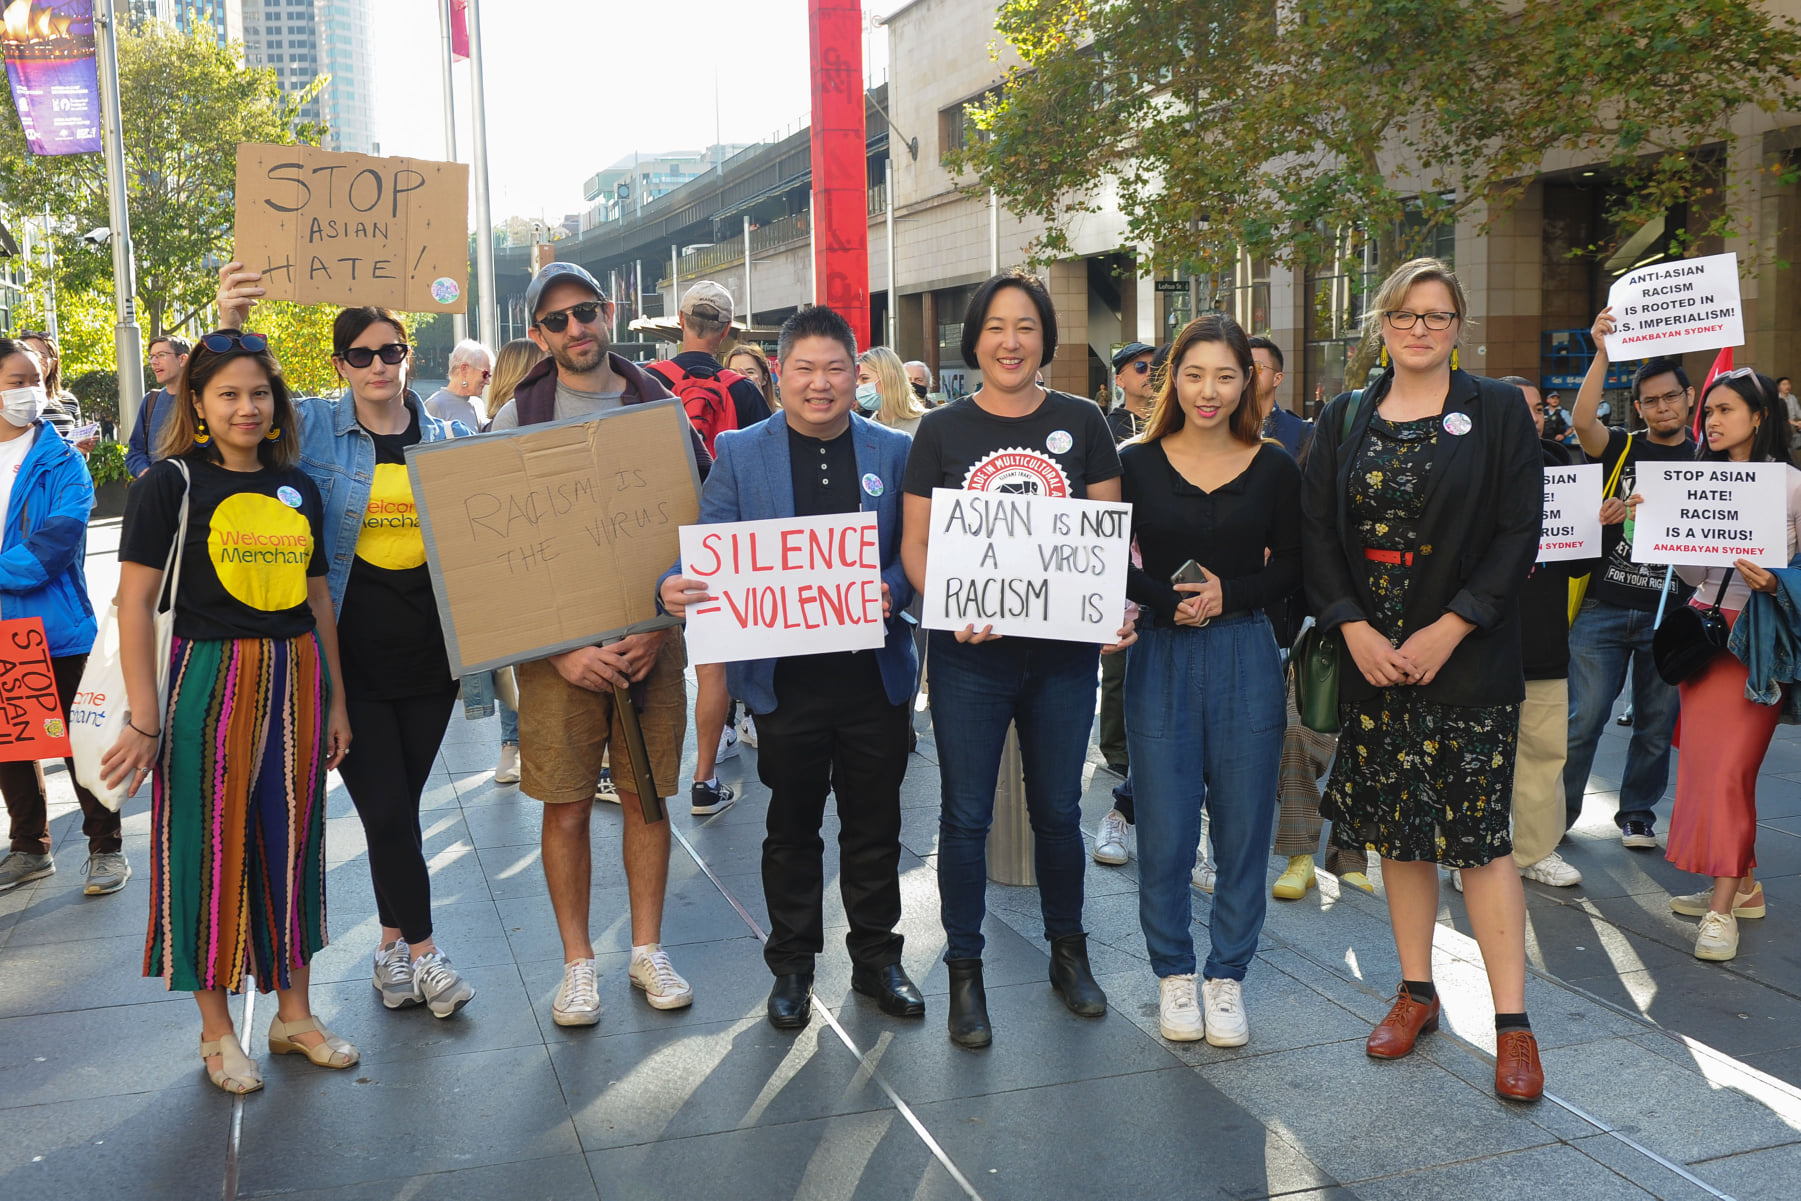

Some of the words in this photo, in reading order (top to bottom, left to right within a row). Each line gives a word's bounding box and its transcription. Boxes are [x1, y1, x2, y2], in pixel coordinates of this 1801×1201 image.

[264, 162, 426, 218] STOP
[309, 217, 388, 244] ASIAN
[261, 245, 427, 285] HATE!
[1629, 265, 1705, 286] ANTI-ASIAN
[1642, 282, 1694, 298] RACISM
[1625, 306, 1638, 316] IS
[1642, 298, 1696, 314] ROOTED
[1701, 295, 1714, 305] IN
[1639, 307, 1735, 330] IMPERIALISM!
[1622, 330, 1682, 344] ANAKBAYAN
[1684, 324, 1724, 336] SYDNEY
[983, 463, 996, 475] IN
[995, 456, 1062, 489] MULTICULTURAL
[1664, 470, 1705, 481] STOP
[1709, 471, 1756, 482] ASIAN
[464, 478, 597, 542] RACISM
[615, 469, 647, 492] IS
[1688, 490, 1732, 501] HATE!
[944, 496, 1032, 539] ASIAN
[1053, 512, 1071, 537] IS
[1080, 510, 1129, 539] NOT
[1680, 509, 1739, 521] RACISM
[219, 531, 307, 547] Welcome
[497, 536, 561, 575] THE
[585, 501, 669, 547] VIRUS
[1546, 541, 1584, 550] SYDNEY
[1666, 527, 1681, 538] IS
[1686, 528, 1696, 539] A
[1701, 529, 1753, 541] VIRUS!
[690, 525, 877, 576] SILENCE
[980, 542, 998, 570] A
[1038, 544, 1105, 576] VIRUS
[1653, 543, 1719, 554] ANAKBAYAN
[1722, 547, 1765, 556] SYDNEY
[1608, 568, 1626, 582] FOR
[1626, 573, 1648, 587] YOUR
[944, 577, 1048, 621] RACISM
[1081, 592, 1104, 624] IS
[12, 629, 57, 712] STOP
[0, 659, 35, 742] ASIAN
